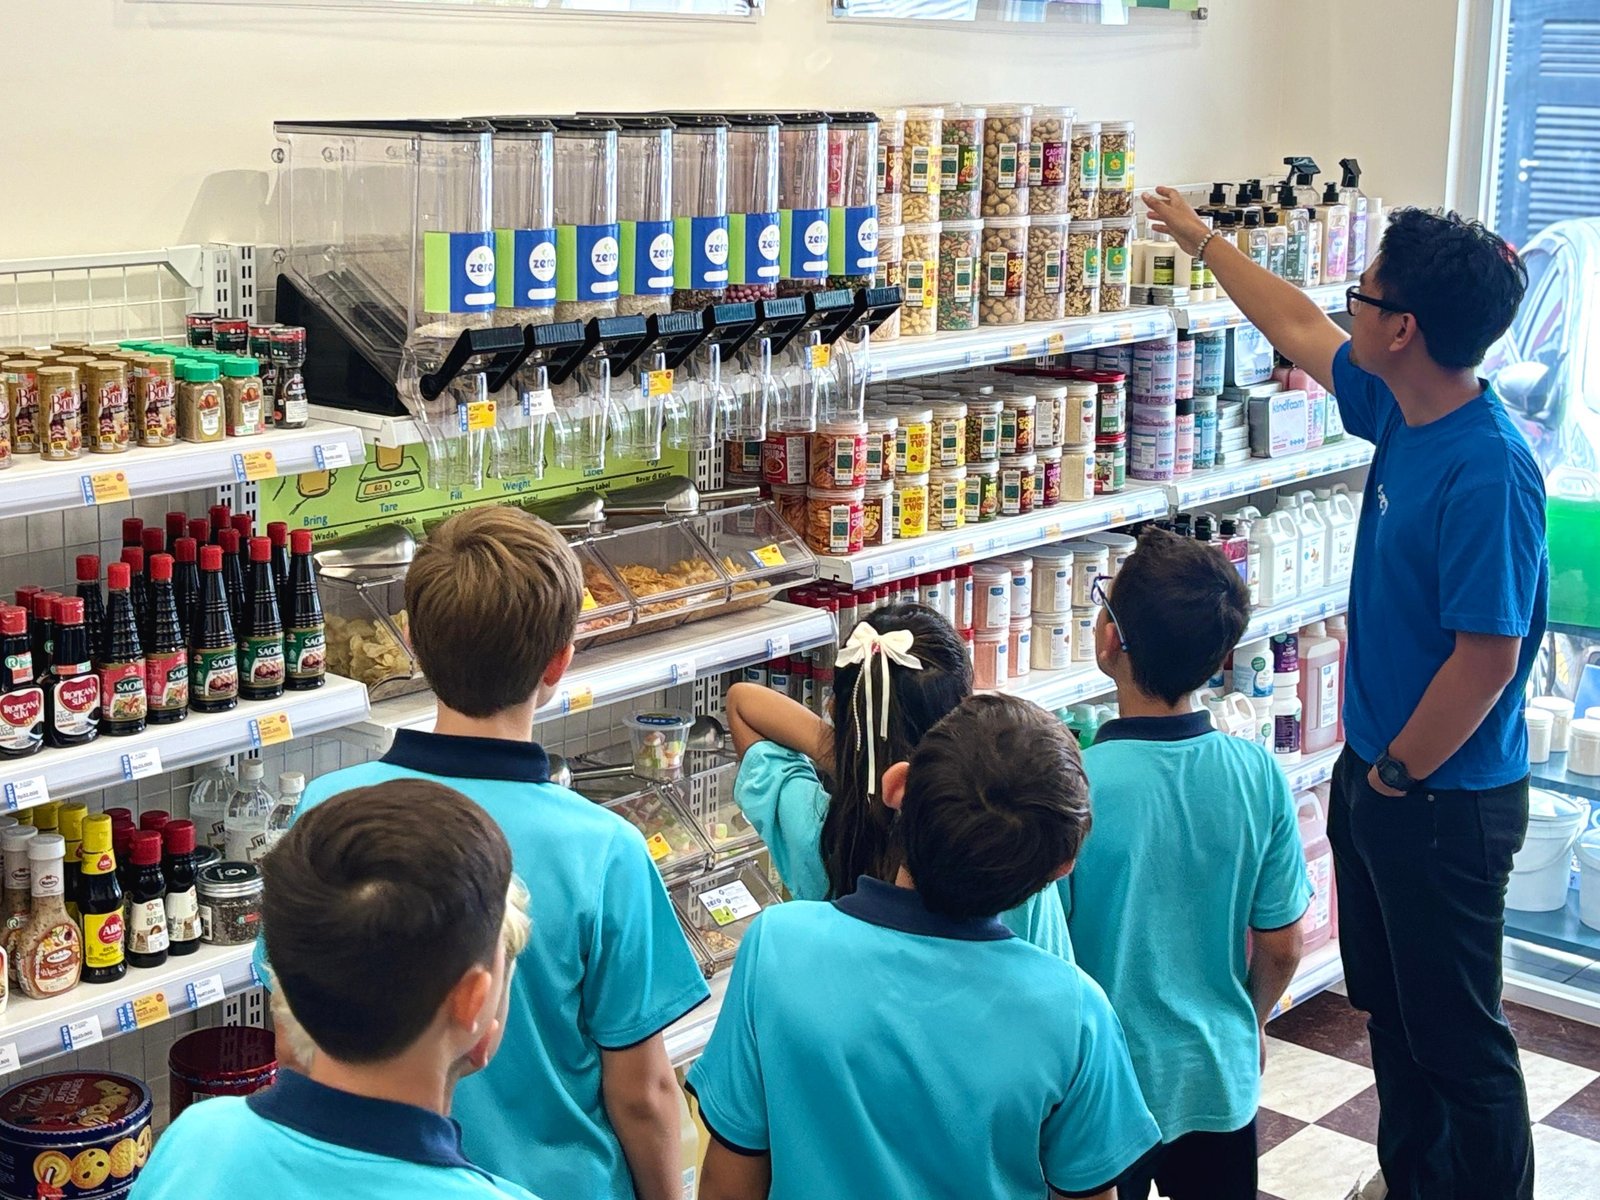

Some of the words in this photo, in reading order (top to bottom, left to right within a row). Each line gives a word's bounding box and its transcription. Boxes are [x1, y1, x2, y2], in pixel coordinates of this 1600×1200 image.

[653, 248, 673, 258] zero
[708, 243, 728, 253] zero
[595, 252, 617, 262] zero
[533, 257, 556, 268] zero
[469, 263, 493, 273] zero
[1273, 399, 1305, 413] kindfoam
[503, 479, 531, 492] Weight
[595, 481, 611, 490] Label
[450, 490, 463, 500] Fill
[380, 503, 398, 512] Tare
[303, 515, 328, 527] Bring
[314, 529, 339, 541] Wadah
[63, 685, 97, 701] TROPICANA
[71, 696, 87, 706] SLIM
[3, 700, 39, 714] TROPICANA
[102, 923, 122, 935] ABC
